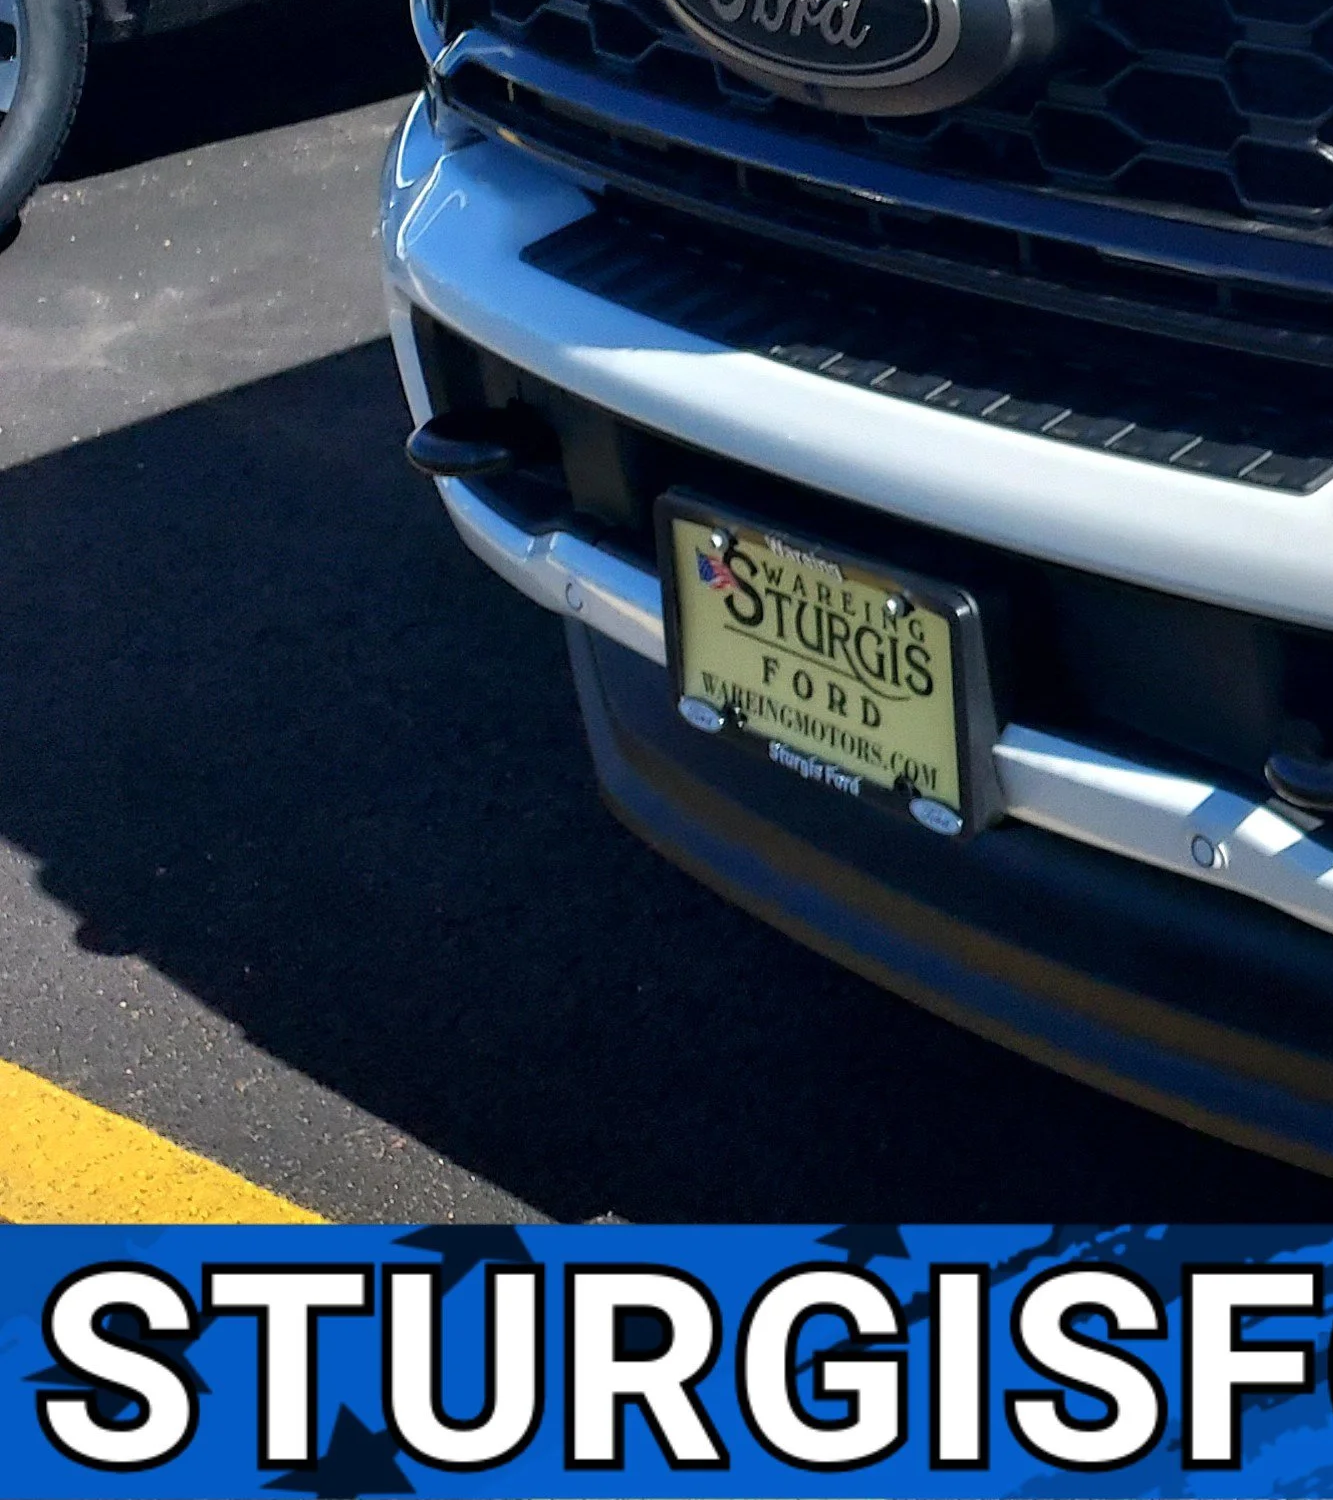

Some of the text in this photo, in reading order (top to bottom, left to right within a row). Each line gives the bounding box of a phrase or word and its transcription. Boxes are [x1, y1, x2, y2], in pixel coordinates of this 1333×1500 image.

[722, 548, 935, 700] STURGIS
[761, 560, 926, 644] WAREING
[701, 671, 938, 791] WAREINGMOTORS.COM
[761, 655, 883, 729] FORD
